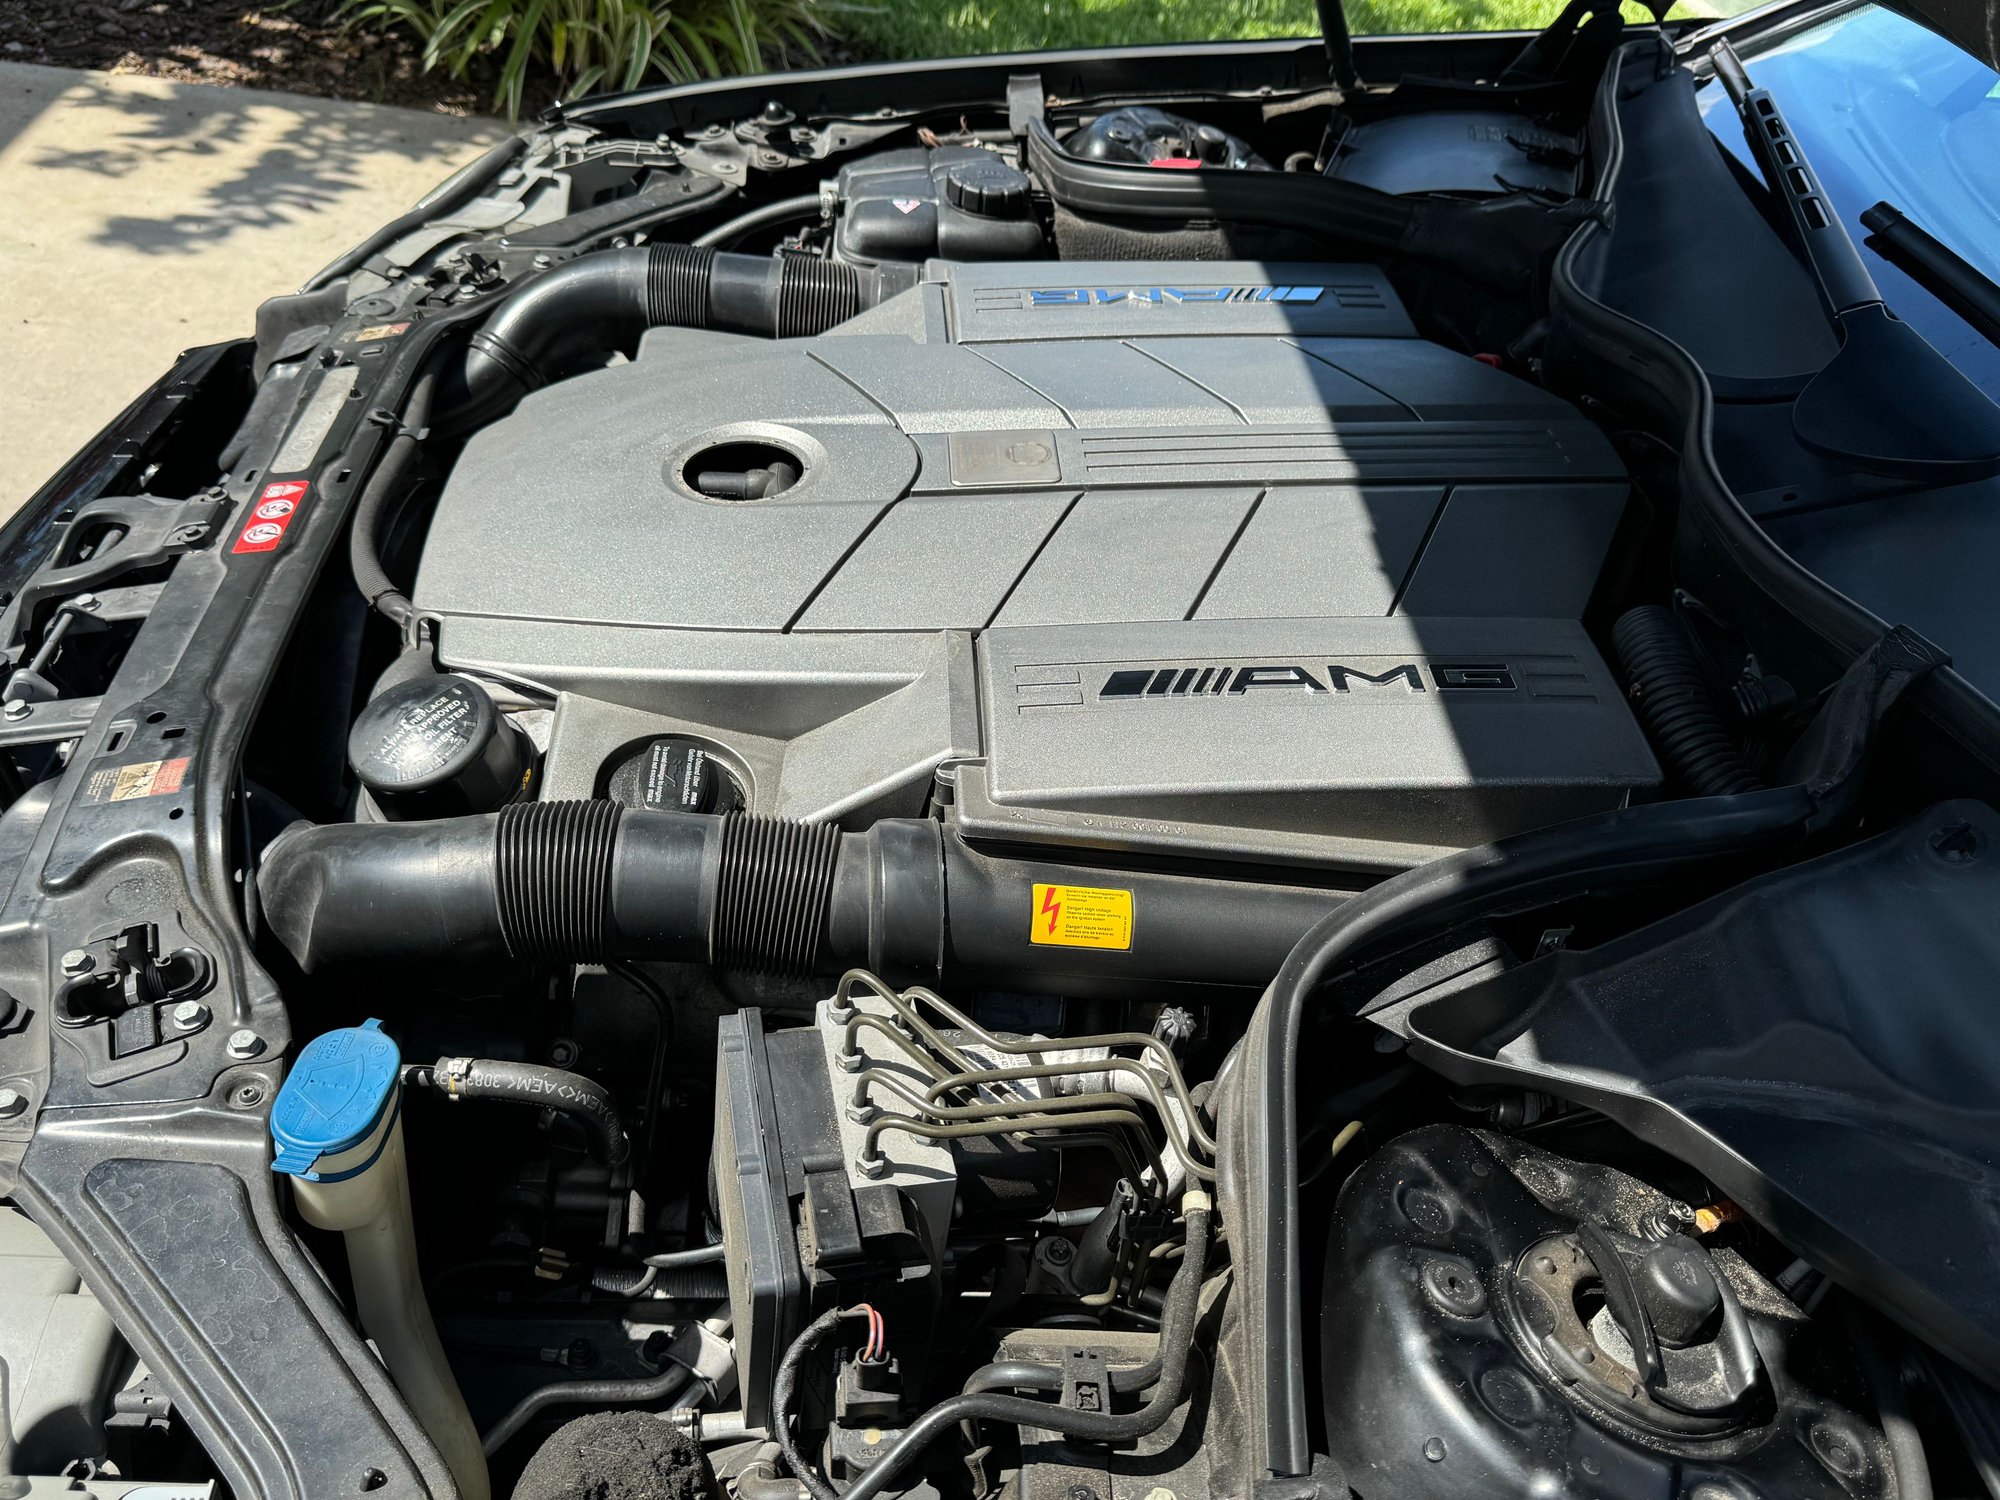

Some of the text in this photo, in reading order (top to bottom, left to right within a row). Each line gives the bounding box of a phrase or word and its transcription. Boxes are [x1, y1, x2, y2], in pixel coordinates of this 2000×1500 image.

[1030, 286, 1233, 306] AMG
[1227, 663, 1517, 695] AMG
[380, 722, 411, 756] ALWAY
[410, 696, 449, 726] REPLACE
[383, 744, 403, 765] WITH
[418, 699, 461, 733] APPROVED
[424, 727, 440, 741] OIL
[438, 707, 468, 730] FILTER
